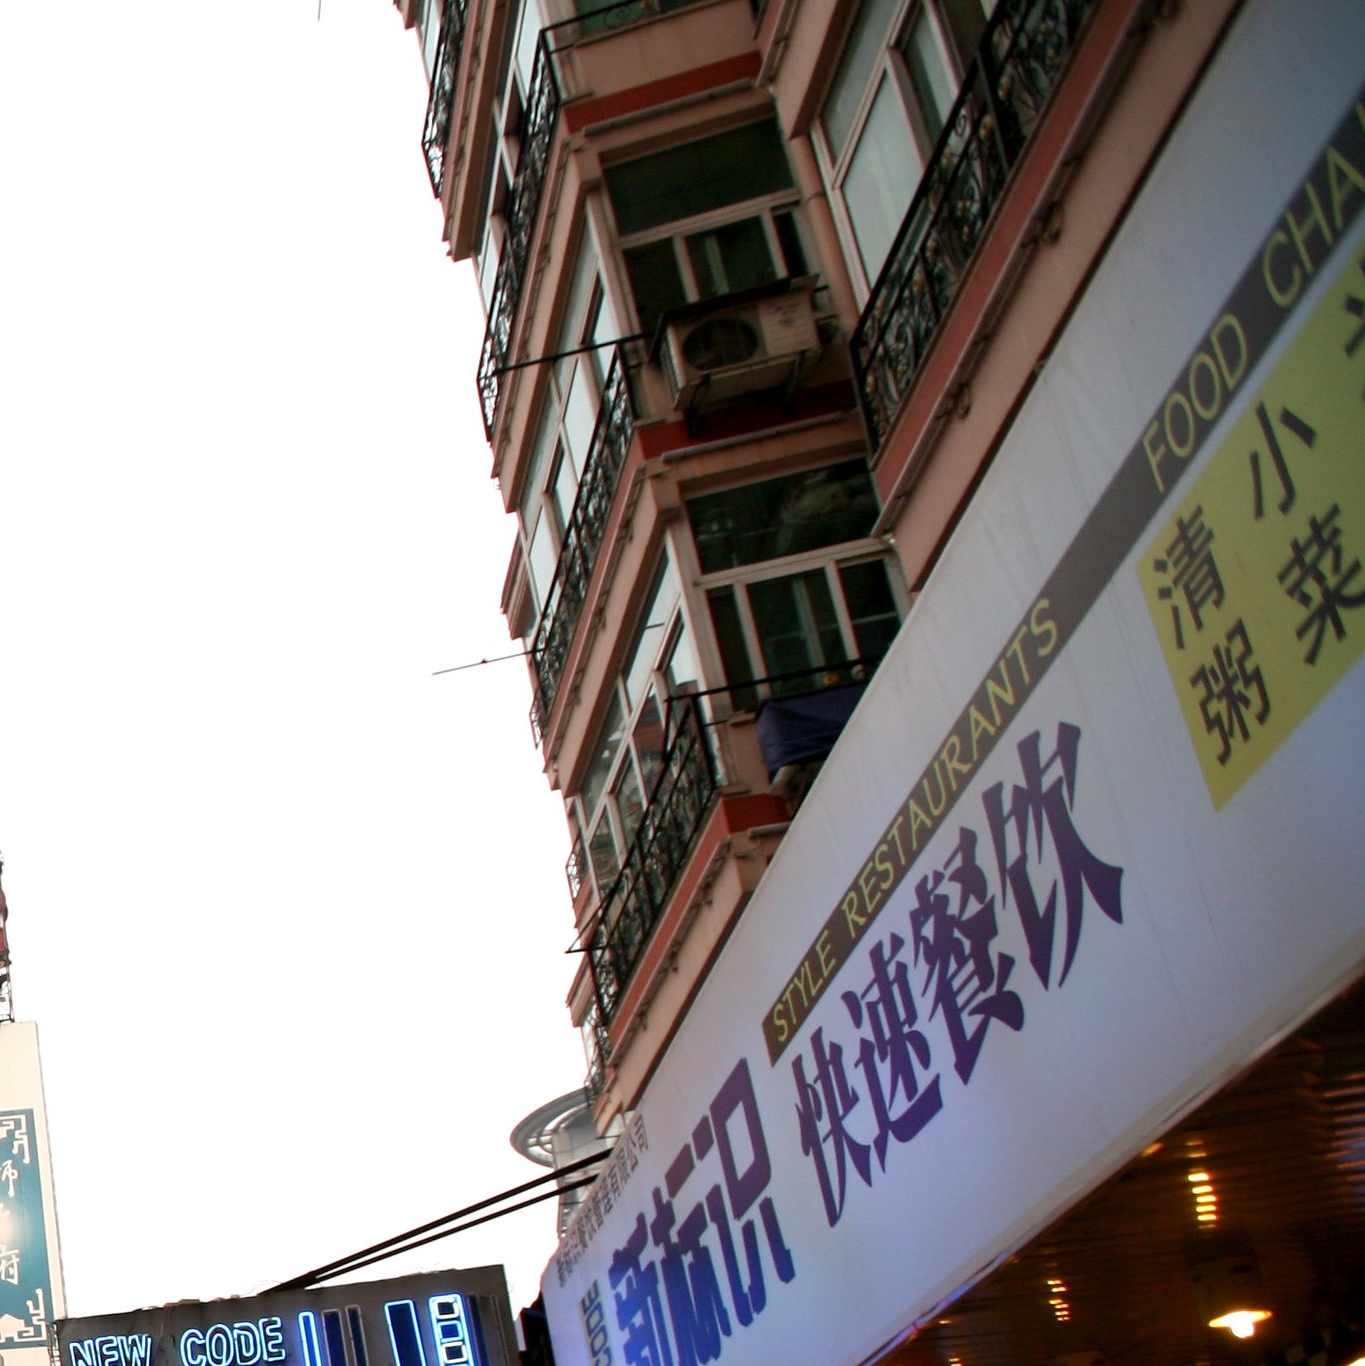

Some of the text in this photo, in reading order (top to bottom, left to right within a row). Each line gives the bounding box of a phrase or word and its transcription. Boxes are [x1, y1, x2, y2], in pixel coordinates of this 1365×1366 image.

[772, 103, 1365, 1044] STYLE RESTAURANTS FOOD CHA
[793, 721, 1124, 1227] 快速餐饮
